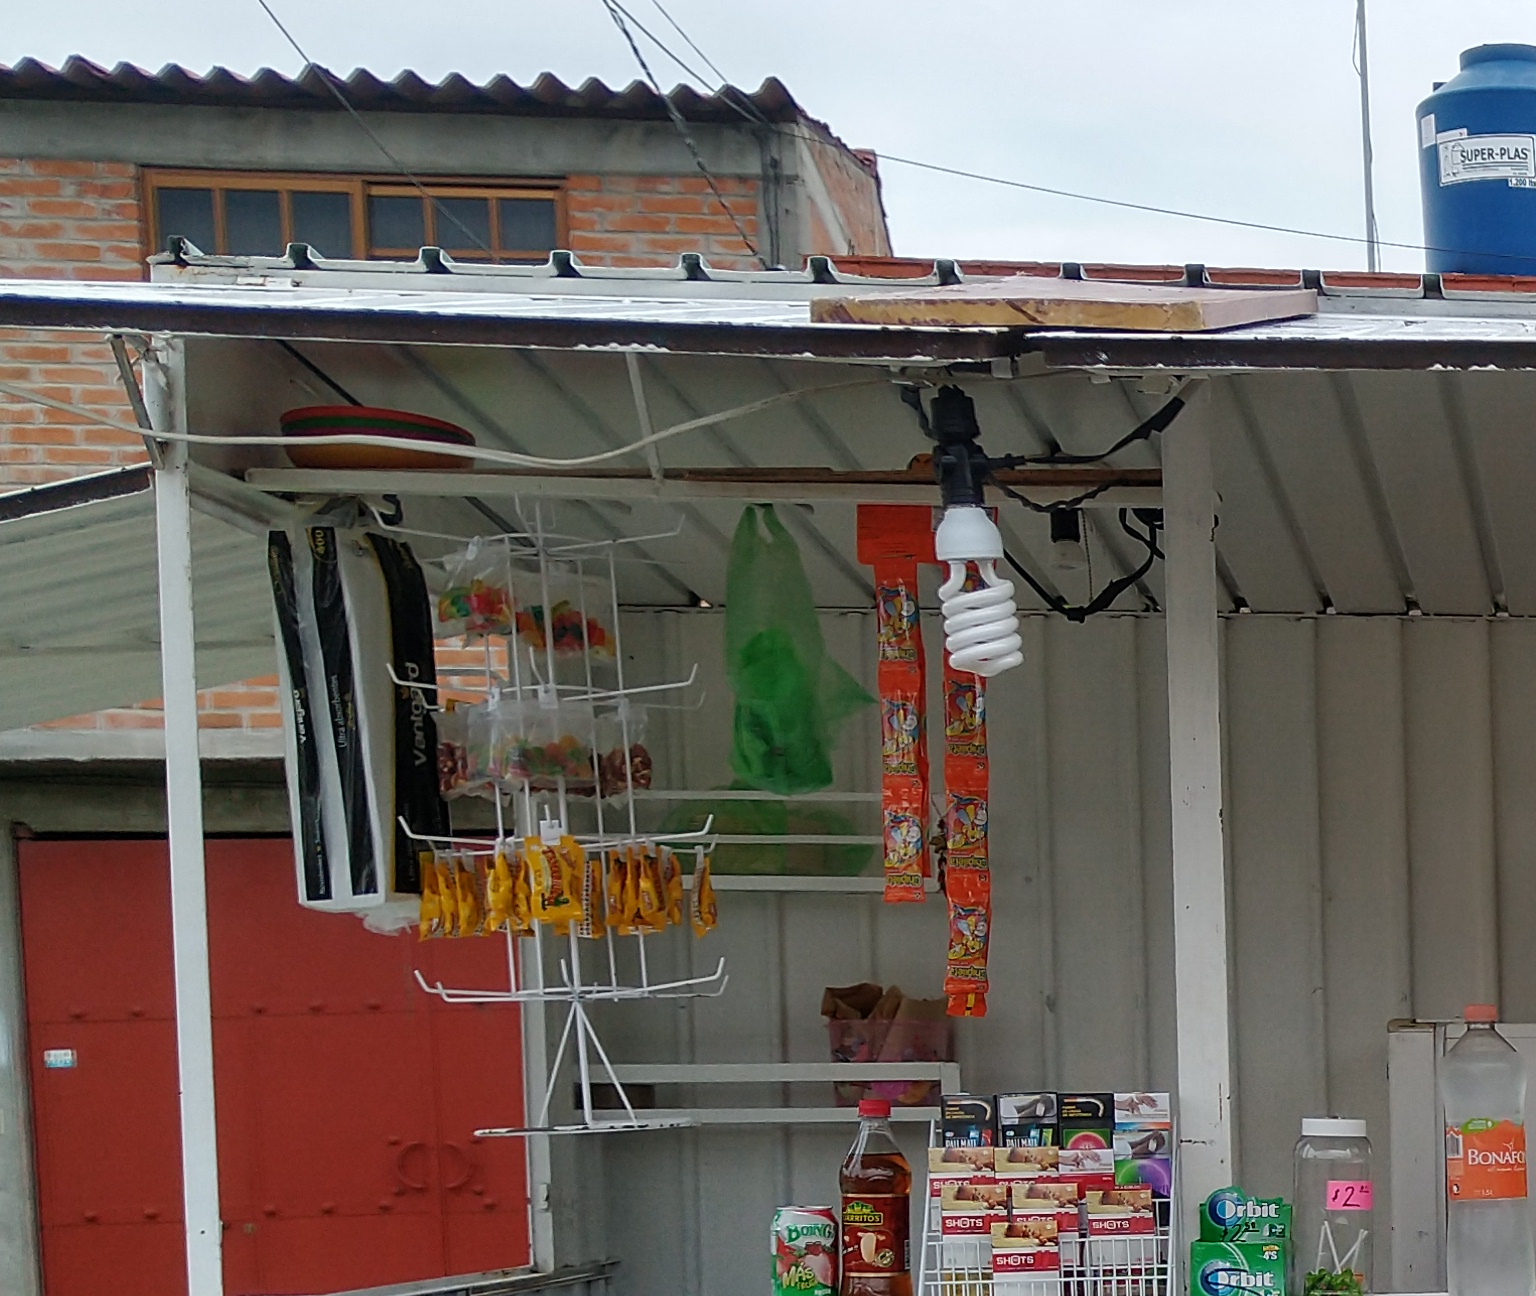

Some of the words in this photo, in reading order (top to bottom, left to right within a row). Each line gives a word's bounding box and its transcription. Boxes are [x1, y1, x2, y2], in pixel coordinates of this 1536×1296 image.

[1460, 147, 1528, 163] SUPER-PLAS
[404, 662, 428, 767] Vantgad
[1468, 1148, 1526, 1166] BONAFO
[1210, 1196, 1280, 1222] Orbit
[842, 1214, 881, 1222] ARRITOS
[945, 1218, 983, 1229] SHOTS
[1092, 1220, 1130, 1229] SHOTS
[996, 1255, 1034, 1265] SHOTS
